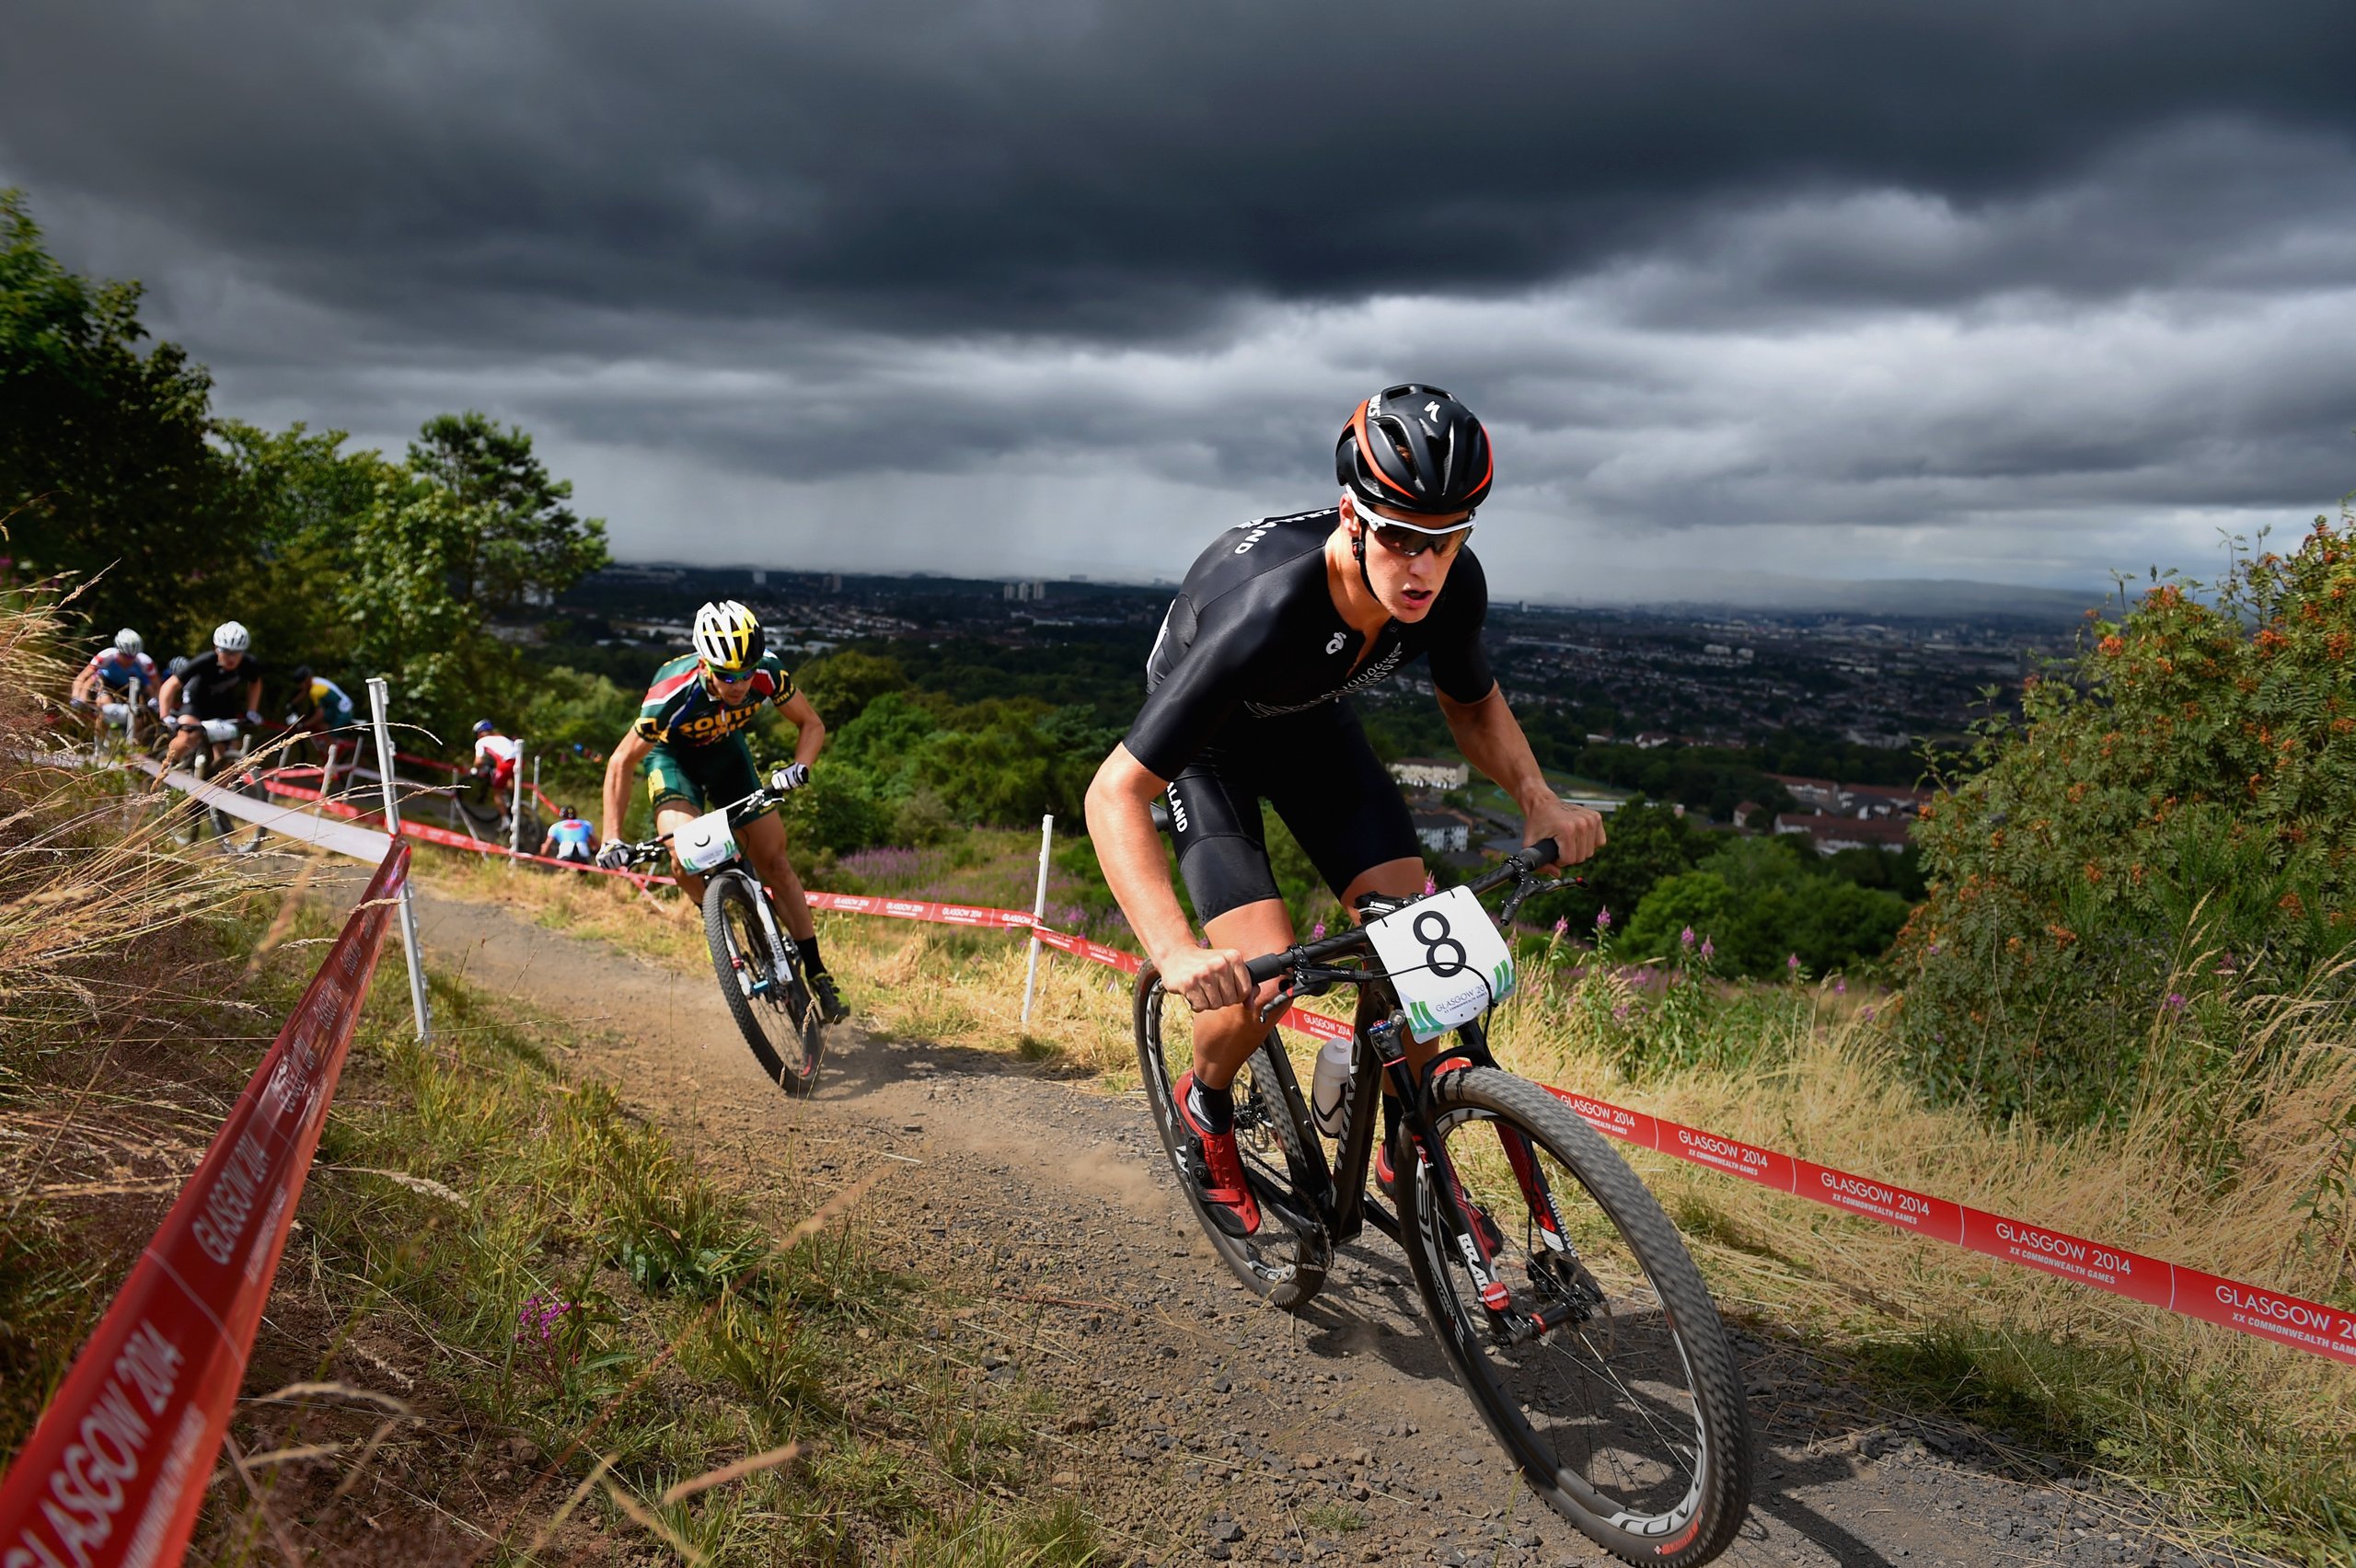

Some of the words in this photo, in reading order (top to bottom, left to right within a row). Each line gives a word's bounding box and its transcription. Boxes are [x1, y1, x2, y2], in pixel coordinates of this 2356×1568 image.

[1167, 781, 1188, 833] LAND
[1413, 910, 1467, 978] 8
[1303, 1013, 1335, 1032] GLASGOW
[1436, 989, 1474, 1012] GLASGOW
[1561, 1095, 1611, 1119] GLASGOW
[1613, 1110, 1635, 1128] 2014
[1679, 1130, 1738, 1159] GLASGOW
[1741, 1148, 1768, 1168] 2014
[1688, 1148, 1696, 1157] XX
[1739, 1164, 1759, 1176] GAMES
[191, 1156, 256, 1265] GLASGOW
[1821, 1171, 1894, 1205] GLASGOW
[1898, 1193, 1931, 1216] 2014
[1832, 1193, 1842, 1201] XX
[1842, 1196, 1894, 1217] COMMONWEALTH
[1895, 1212, 1918, 1225] GAMES
[1457, 1232, 1490, 1302] BRAI
[1995, 1222, 2086, 1262] GLASGOW
[2092, 1250, 2131, 1275] 2014
[2009, 1246, 2020, 1256] XX
[2021, 1250, 2086, 1276] COMMONWEALTH
[2087, 1269, 2115, 1285] GAMES
[2215, 1285, 2330, 1332] GLASGOW
[2232, 1312, 2245, 1323] XX
[2247, 1317, 2329, 1348] COMMONWEALTH
[2331, 1341, 2356, 1356] GAM
[4, 1378, 152, 1568] LASGOW
